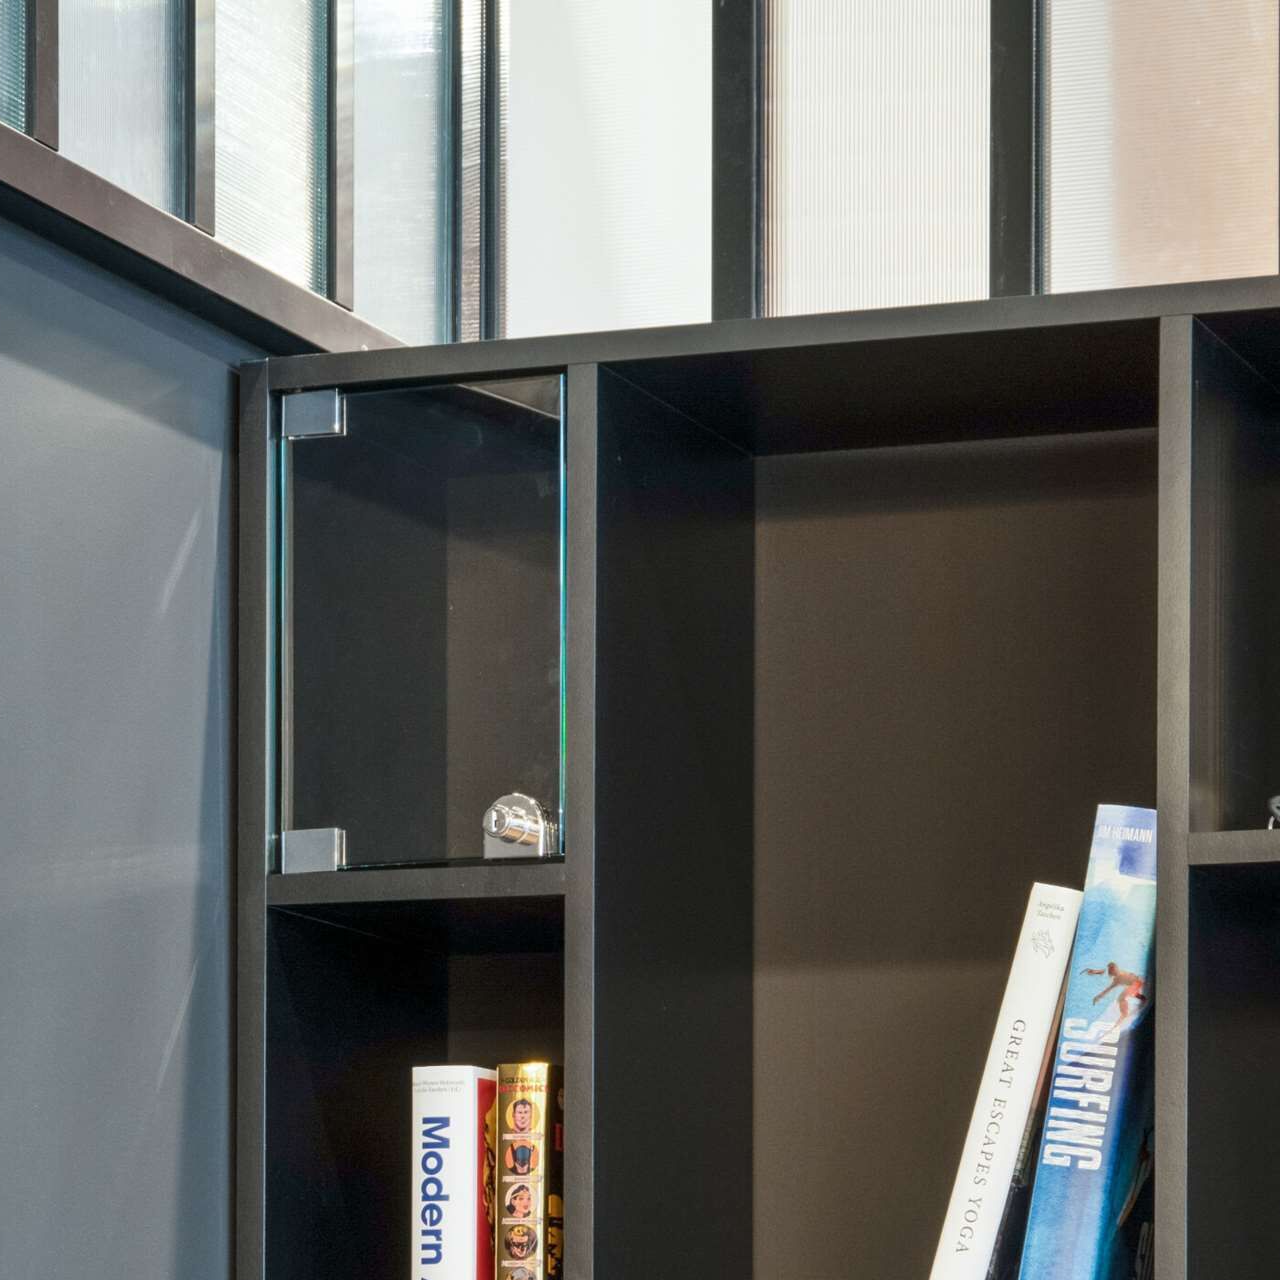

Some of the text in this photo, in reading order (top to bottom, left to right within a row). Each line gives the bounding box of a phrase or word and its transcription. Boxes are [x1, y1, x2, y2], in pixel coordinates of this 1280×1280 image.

[955, 1019, 1026, 1253] GREAT ESCAPES YOGA
[1042, 1018, 1121, 1171] SURFING
[420, 1116, 451, 1265] Modern
